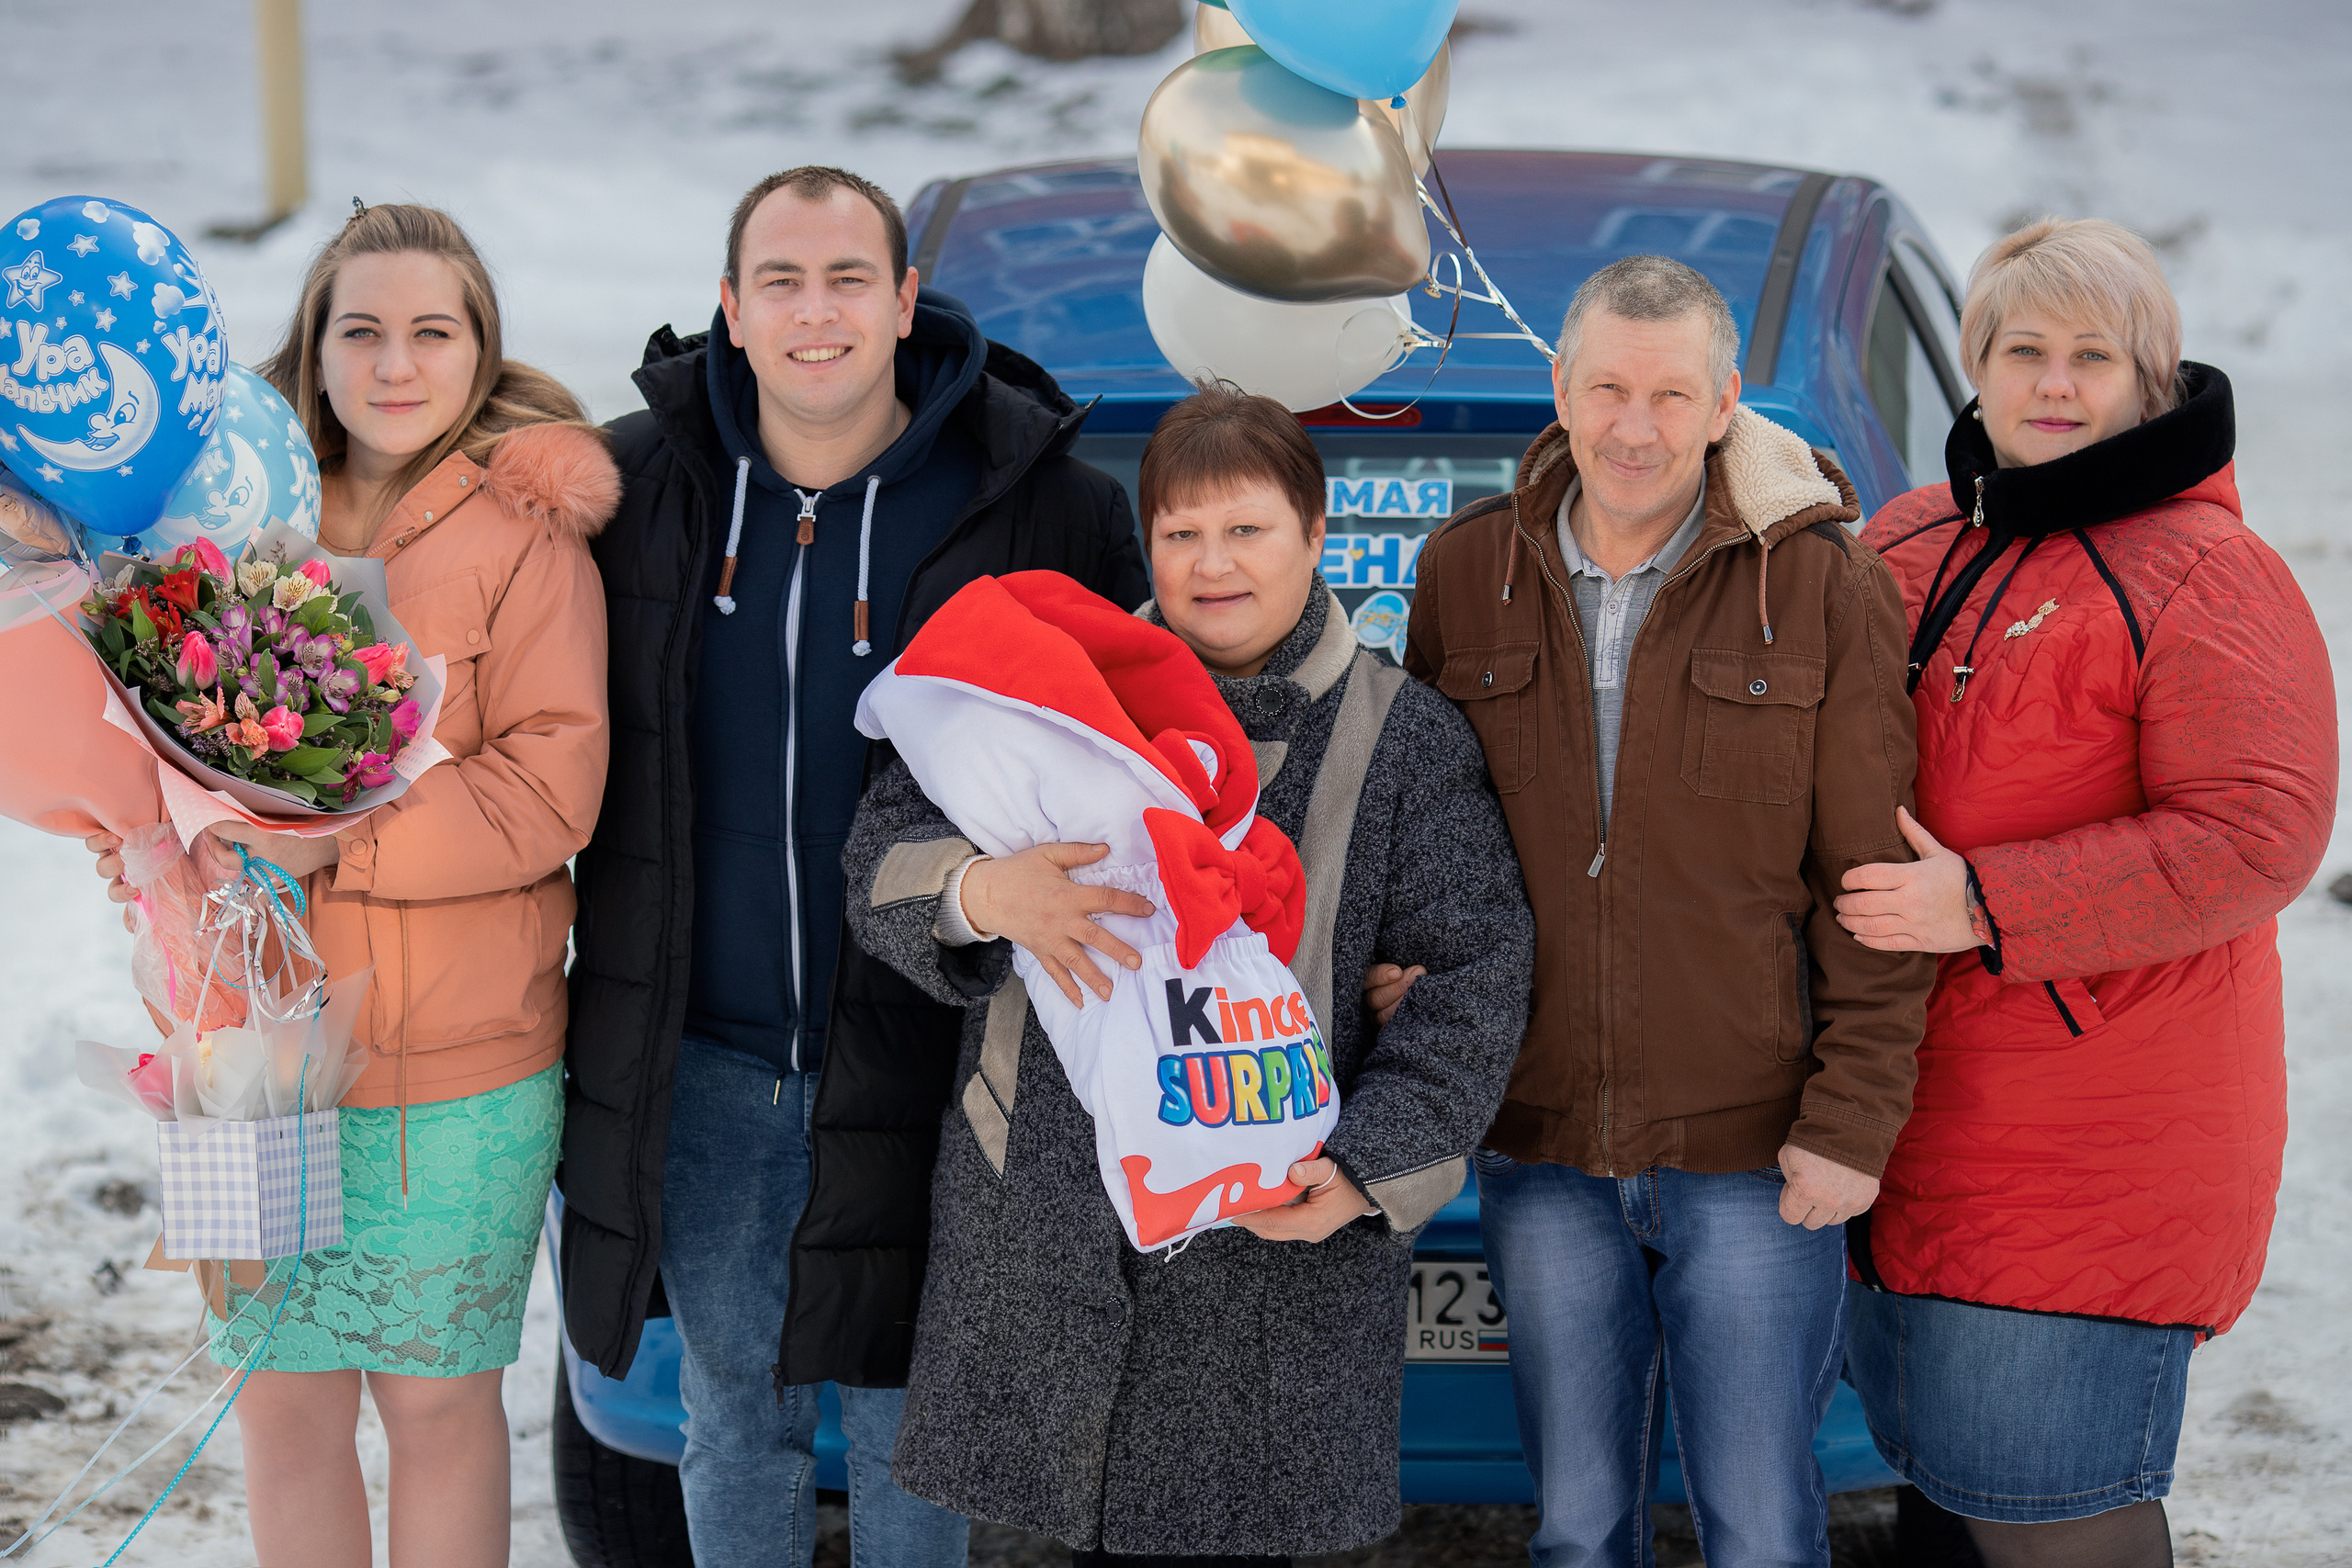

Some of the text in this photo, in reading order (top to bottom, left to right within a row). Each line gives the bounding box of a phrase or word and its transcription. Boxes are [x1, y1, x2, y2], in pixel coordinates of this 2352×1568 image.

[11, 320, 95, 382] Ура
[161, 325, 221, 382] Ура
[1325, 480, 1449, 514] МАЯ
[1420, 1330, 1475, 1349] RUS
